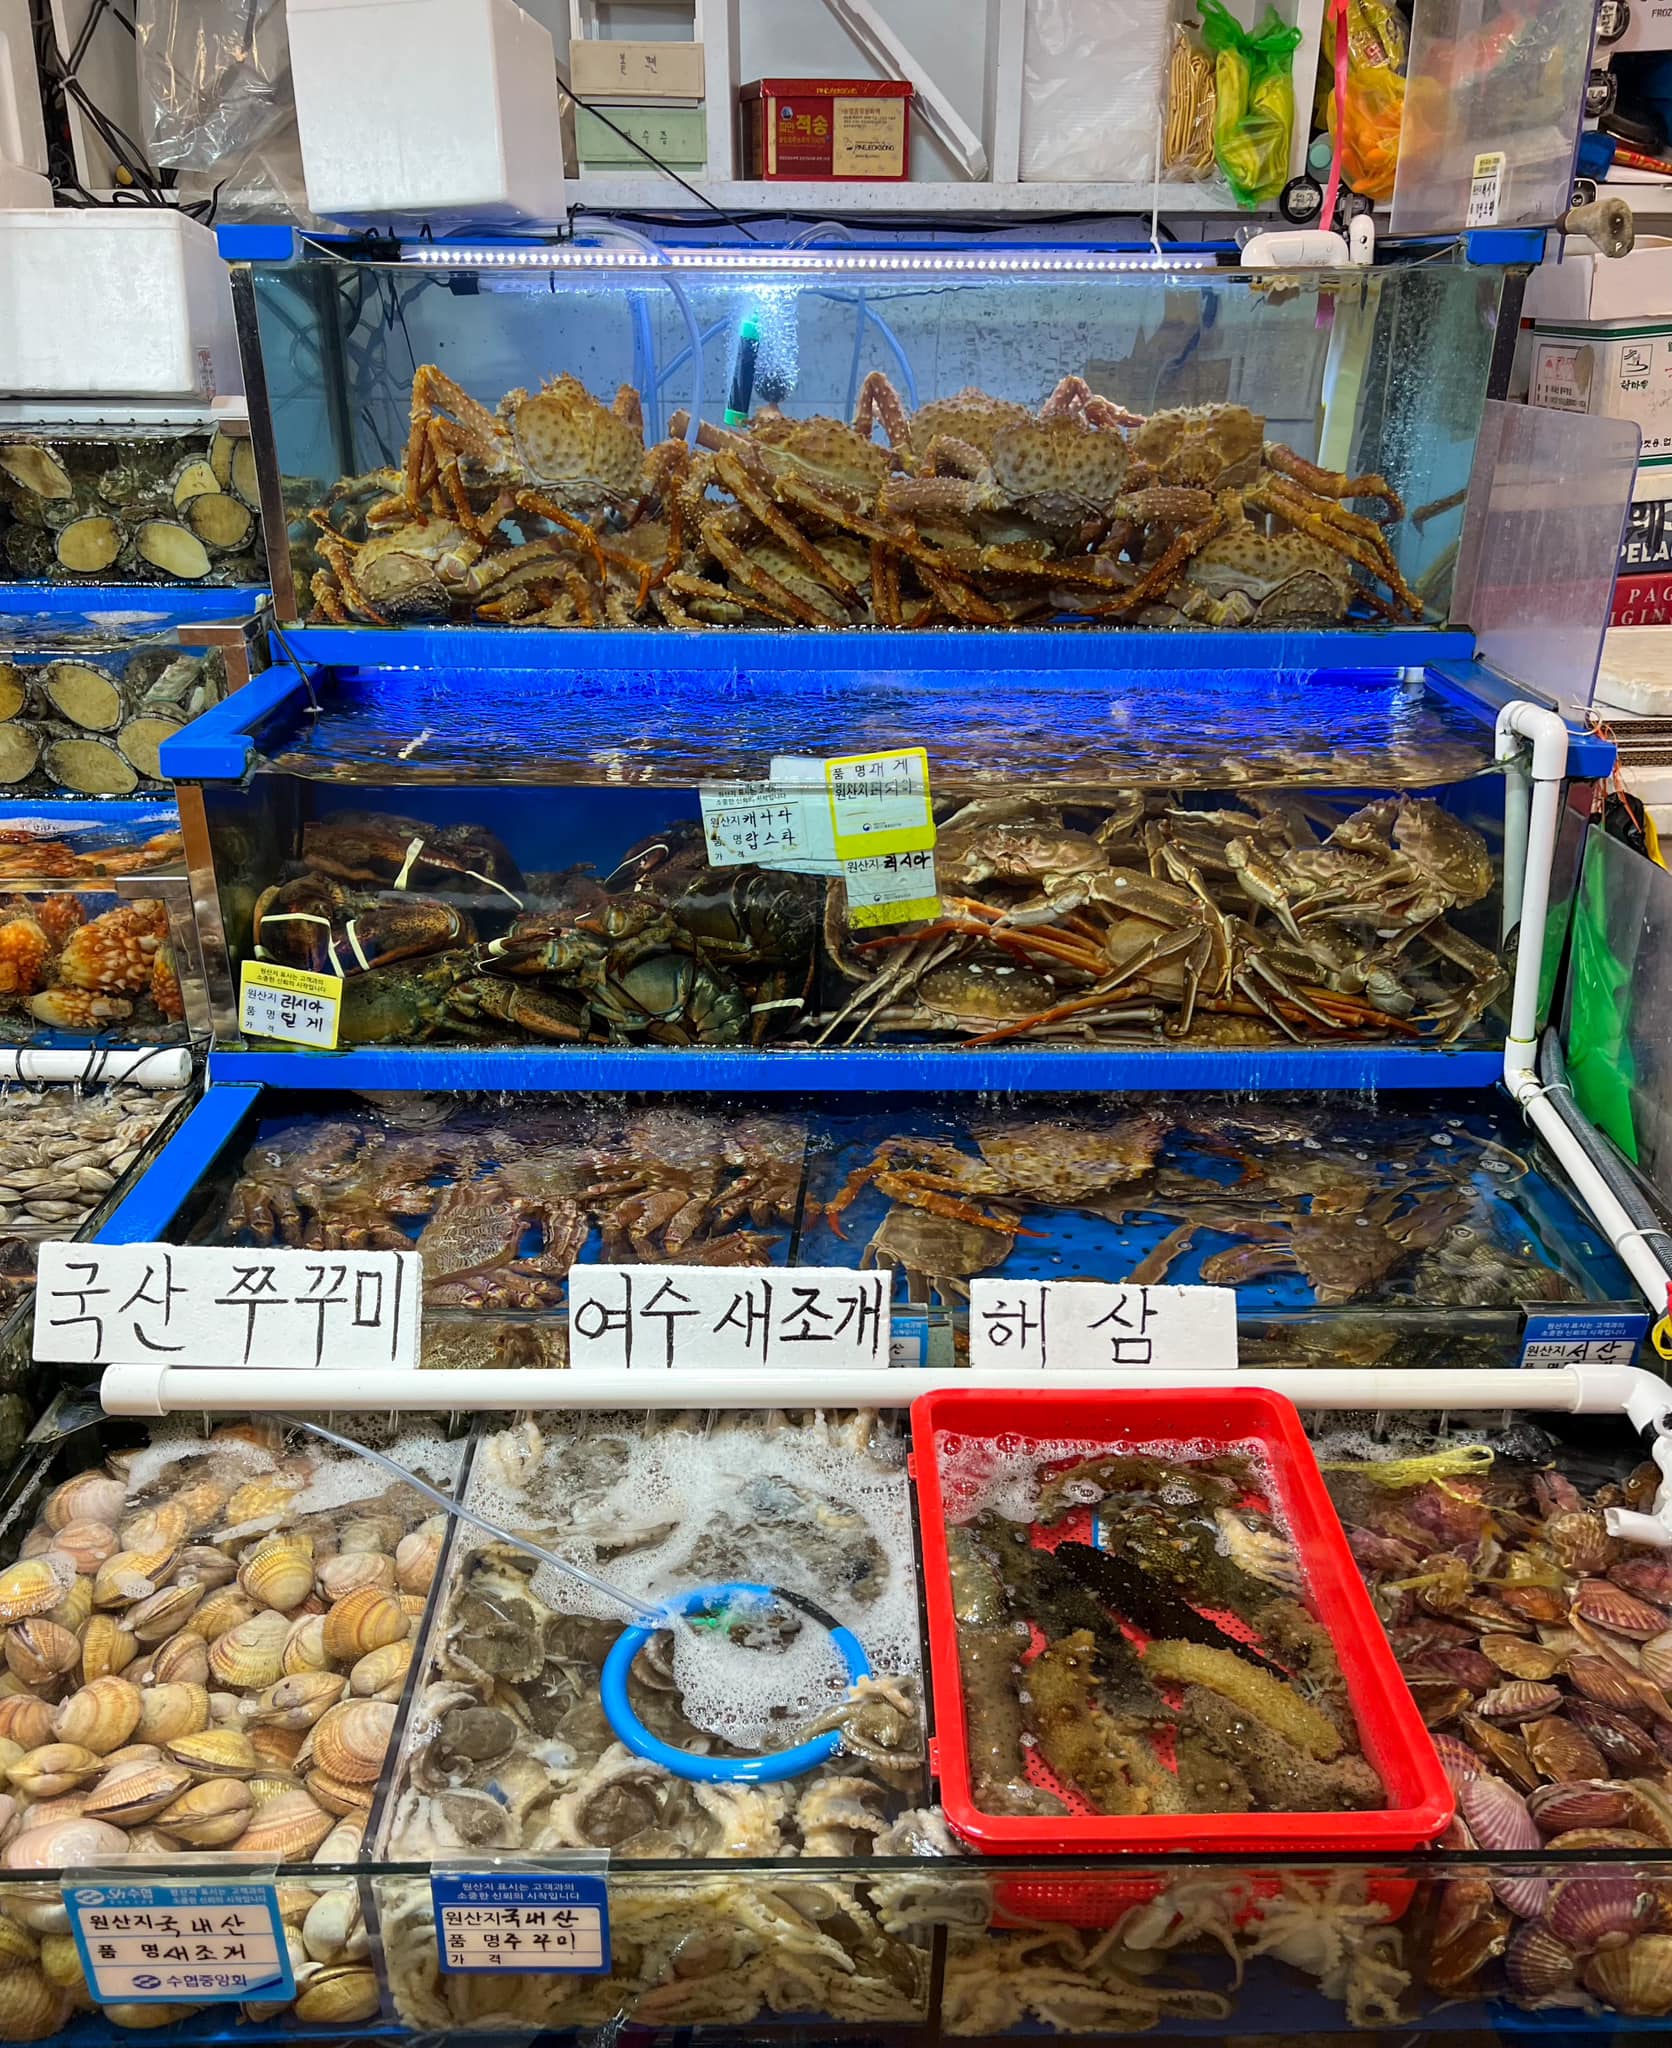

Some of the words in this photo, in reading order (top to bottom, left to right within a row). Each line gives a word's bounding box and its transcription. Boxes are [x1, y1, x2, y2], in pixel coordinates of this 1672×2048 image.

[796, 114, 828, 136] 적송
[847, 858, 879, 873] 원산지
[247, 988, 277, 1003] 원산지
[50, 1253, 189, 1360] 국산
[214, 1252, 404, 1367] 쭈꾸미
[574, 1271, 701, 1368] 여수
[713, 1276, 882, 1366] 새조개
[1527, 1345, 1565, 1357] 원산지
[462, 1882, 494, 1891] 원산지
[497, 1882, 529, 1891] 표시는
[532, 1882, 575, 1891] 고객과의
[457, 1892, 489, 1900] 소중한
[492, 1892, 524, 1900] 신뢰의
[527, 1892, 580, 1900] 시작입니다
[90, 1914, 152, 1930] 원산지
[445, 1911, 500, 1926] 원산지
[166, 1974, 248, 1988] 수협중앙회
